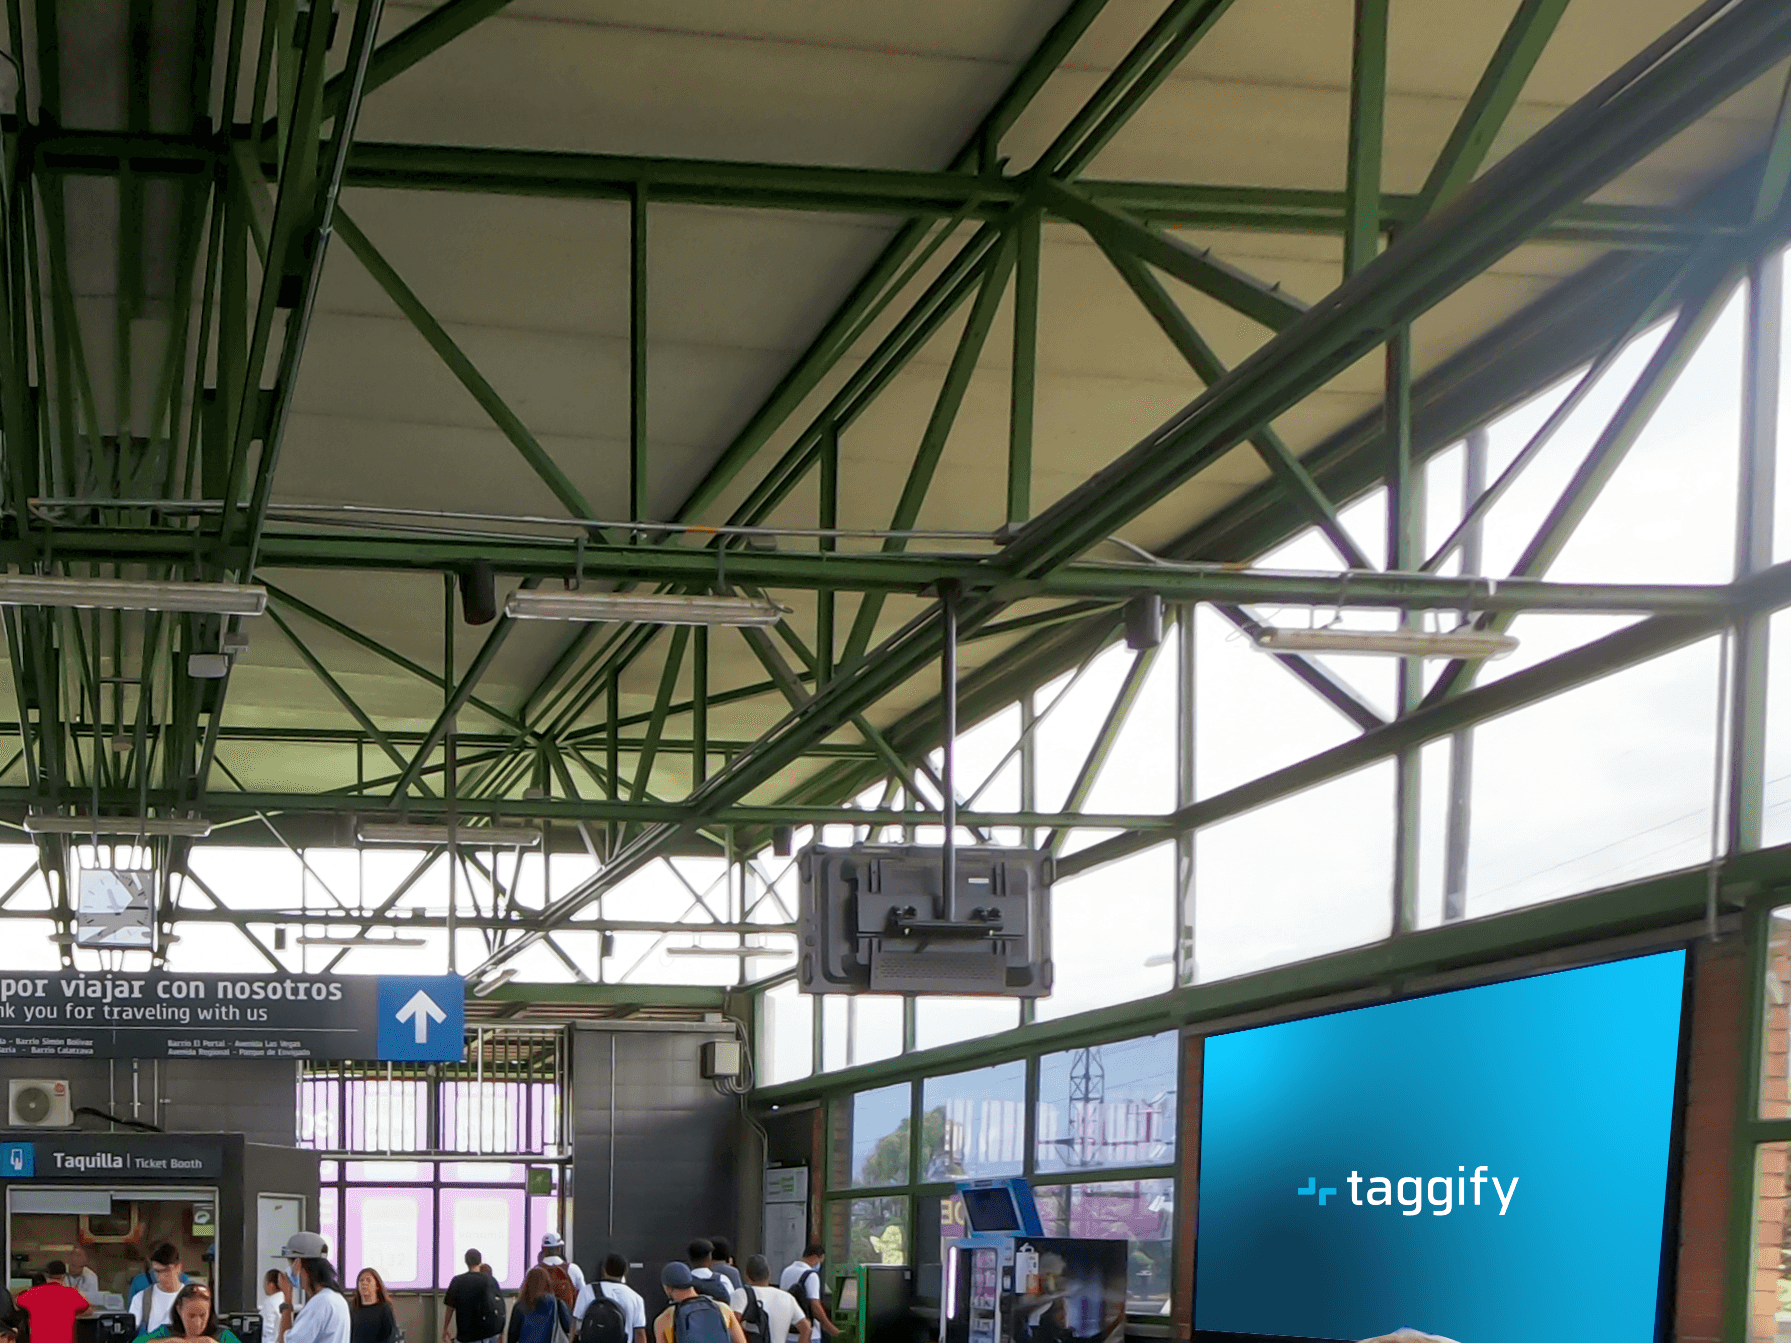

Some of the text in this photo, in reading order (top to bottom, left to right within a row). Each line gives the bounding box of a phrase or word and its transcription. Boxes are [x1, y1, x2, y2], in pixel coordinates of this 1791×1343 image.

[1, 978, 48, 1001] por
[61, 973, 145, 1002] viajar
[157, 980, 205, 998] con
[218, 979, 342, 1001] nosotros
[24, 1005, 57, 1022] you
[65, 1003, 95, 1019] for
[103, 1003, 189, 1024] traveling
[198, 1004, 240, 1020] with
[247, 1008, 268, 1021] us
[31, 1046, 55, 1054] Barrio
[167, 1039, 192, 1047] Barrio
[202, 1039, 225, 1047] Portal
[279, 1040, 301, 1048] Vegas
[198, 1048, 230, 1057] Regional
[278, 1049, 310, 1057] Envigado
[53, 1152, 203, 1171] Taquilla Ticket Booth
[1347, 1166, 1519, 1216] taggify
